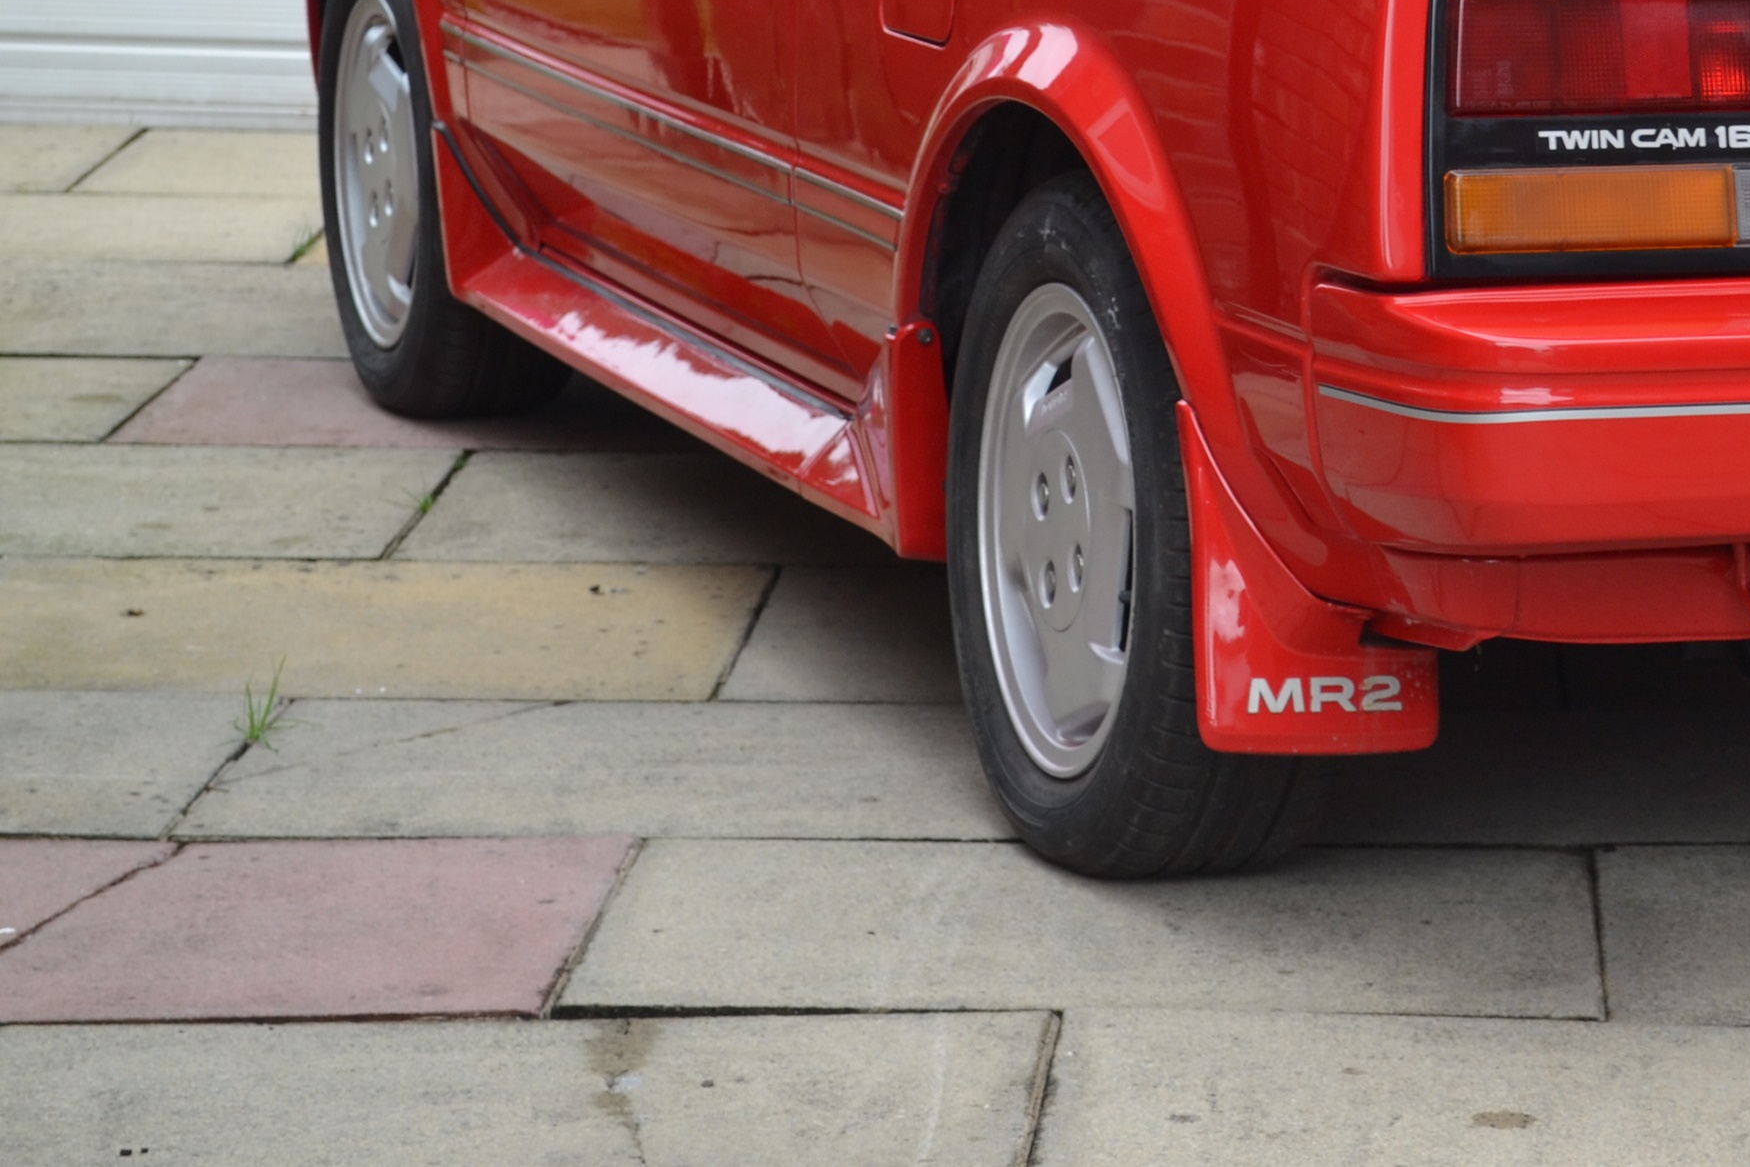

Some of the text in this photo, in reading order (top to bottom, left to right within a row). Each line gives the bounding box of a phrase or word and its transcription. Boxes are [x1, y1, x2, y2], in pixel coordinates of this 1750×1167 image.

[1538, 128, 1625, 151] TWIN
[1631, 126, 1707, 150] CAM
[1247, 675, 1403, 714] MR2
